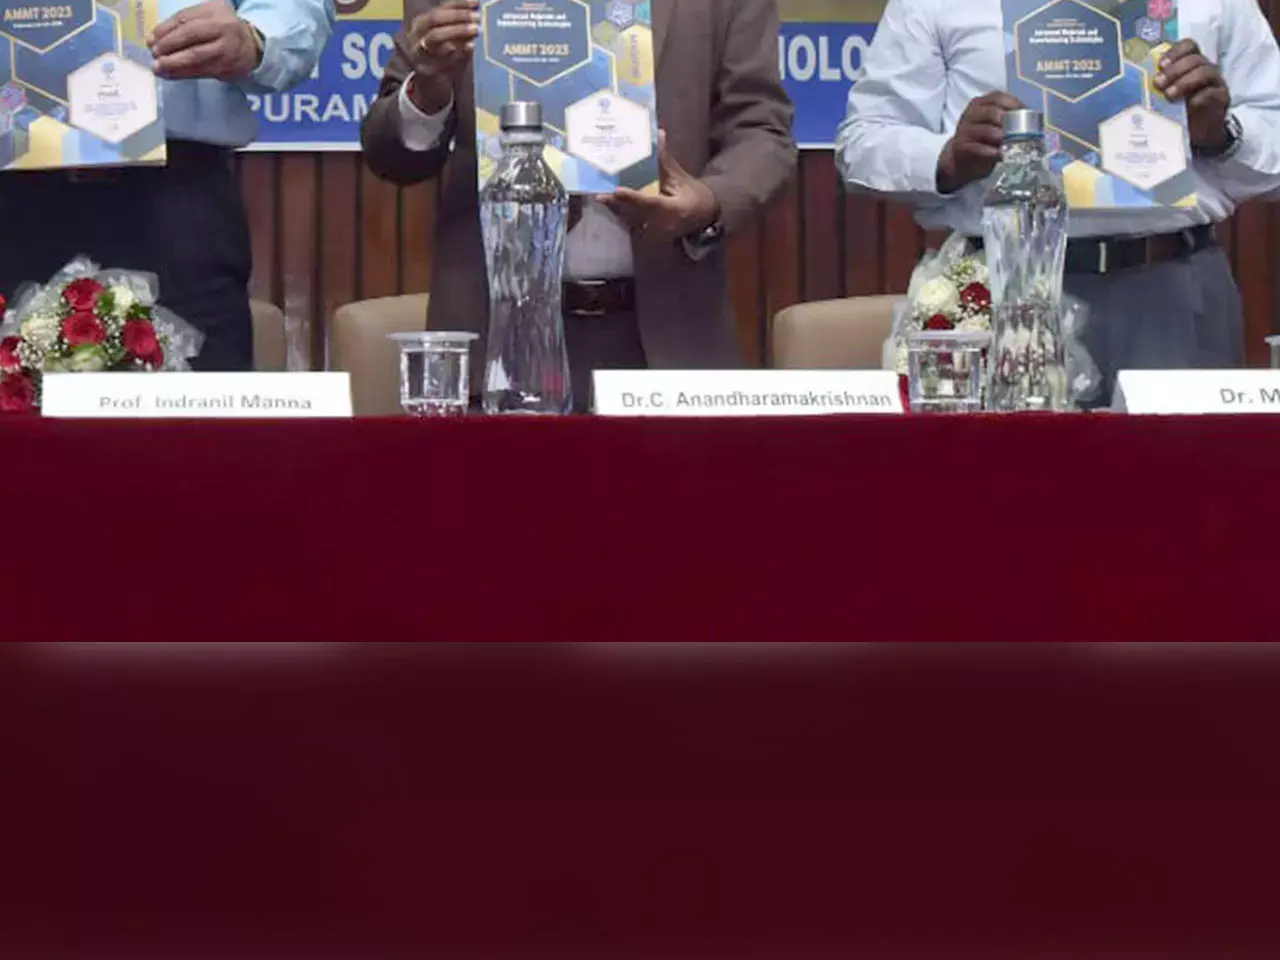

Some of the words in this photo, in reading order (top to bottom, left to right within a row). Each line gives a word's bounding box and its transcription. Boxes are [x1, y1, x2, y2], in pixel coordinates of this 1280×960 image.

[4, 7, 39, 21] AMMT
[42, 5, 72, 18] 2023
[503, 43, 537, 56] AMMT
[540, 43, 569, 55] 2023
[1036, 60, 1070, 72] AMMT
[1072, 59, 1102, 71] 2023
[155, 394, 234, 409] Indranil
[241, 394, 312, 410] Manna
[676, 390, 892, 408] Anandharamakrishnan
[1220, 388, 1254, 404] Dr.
